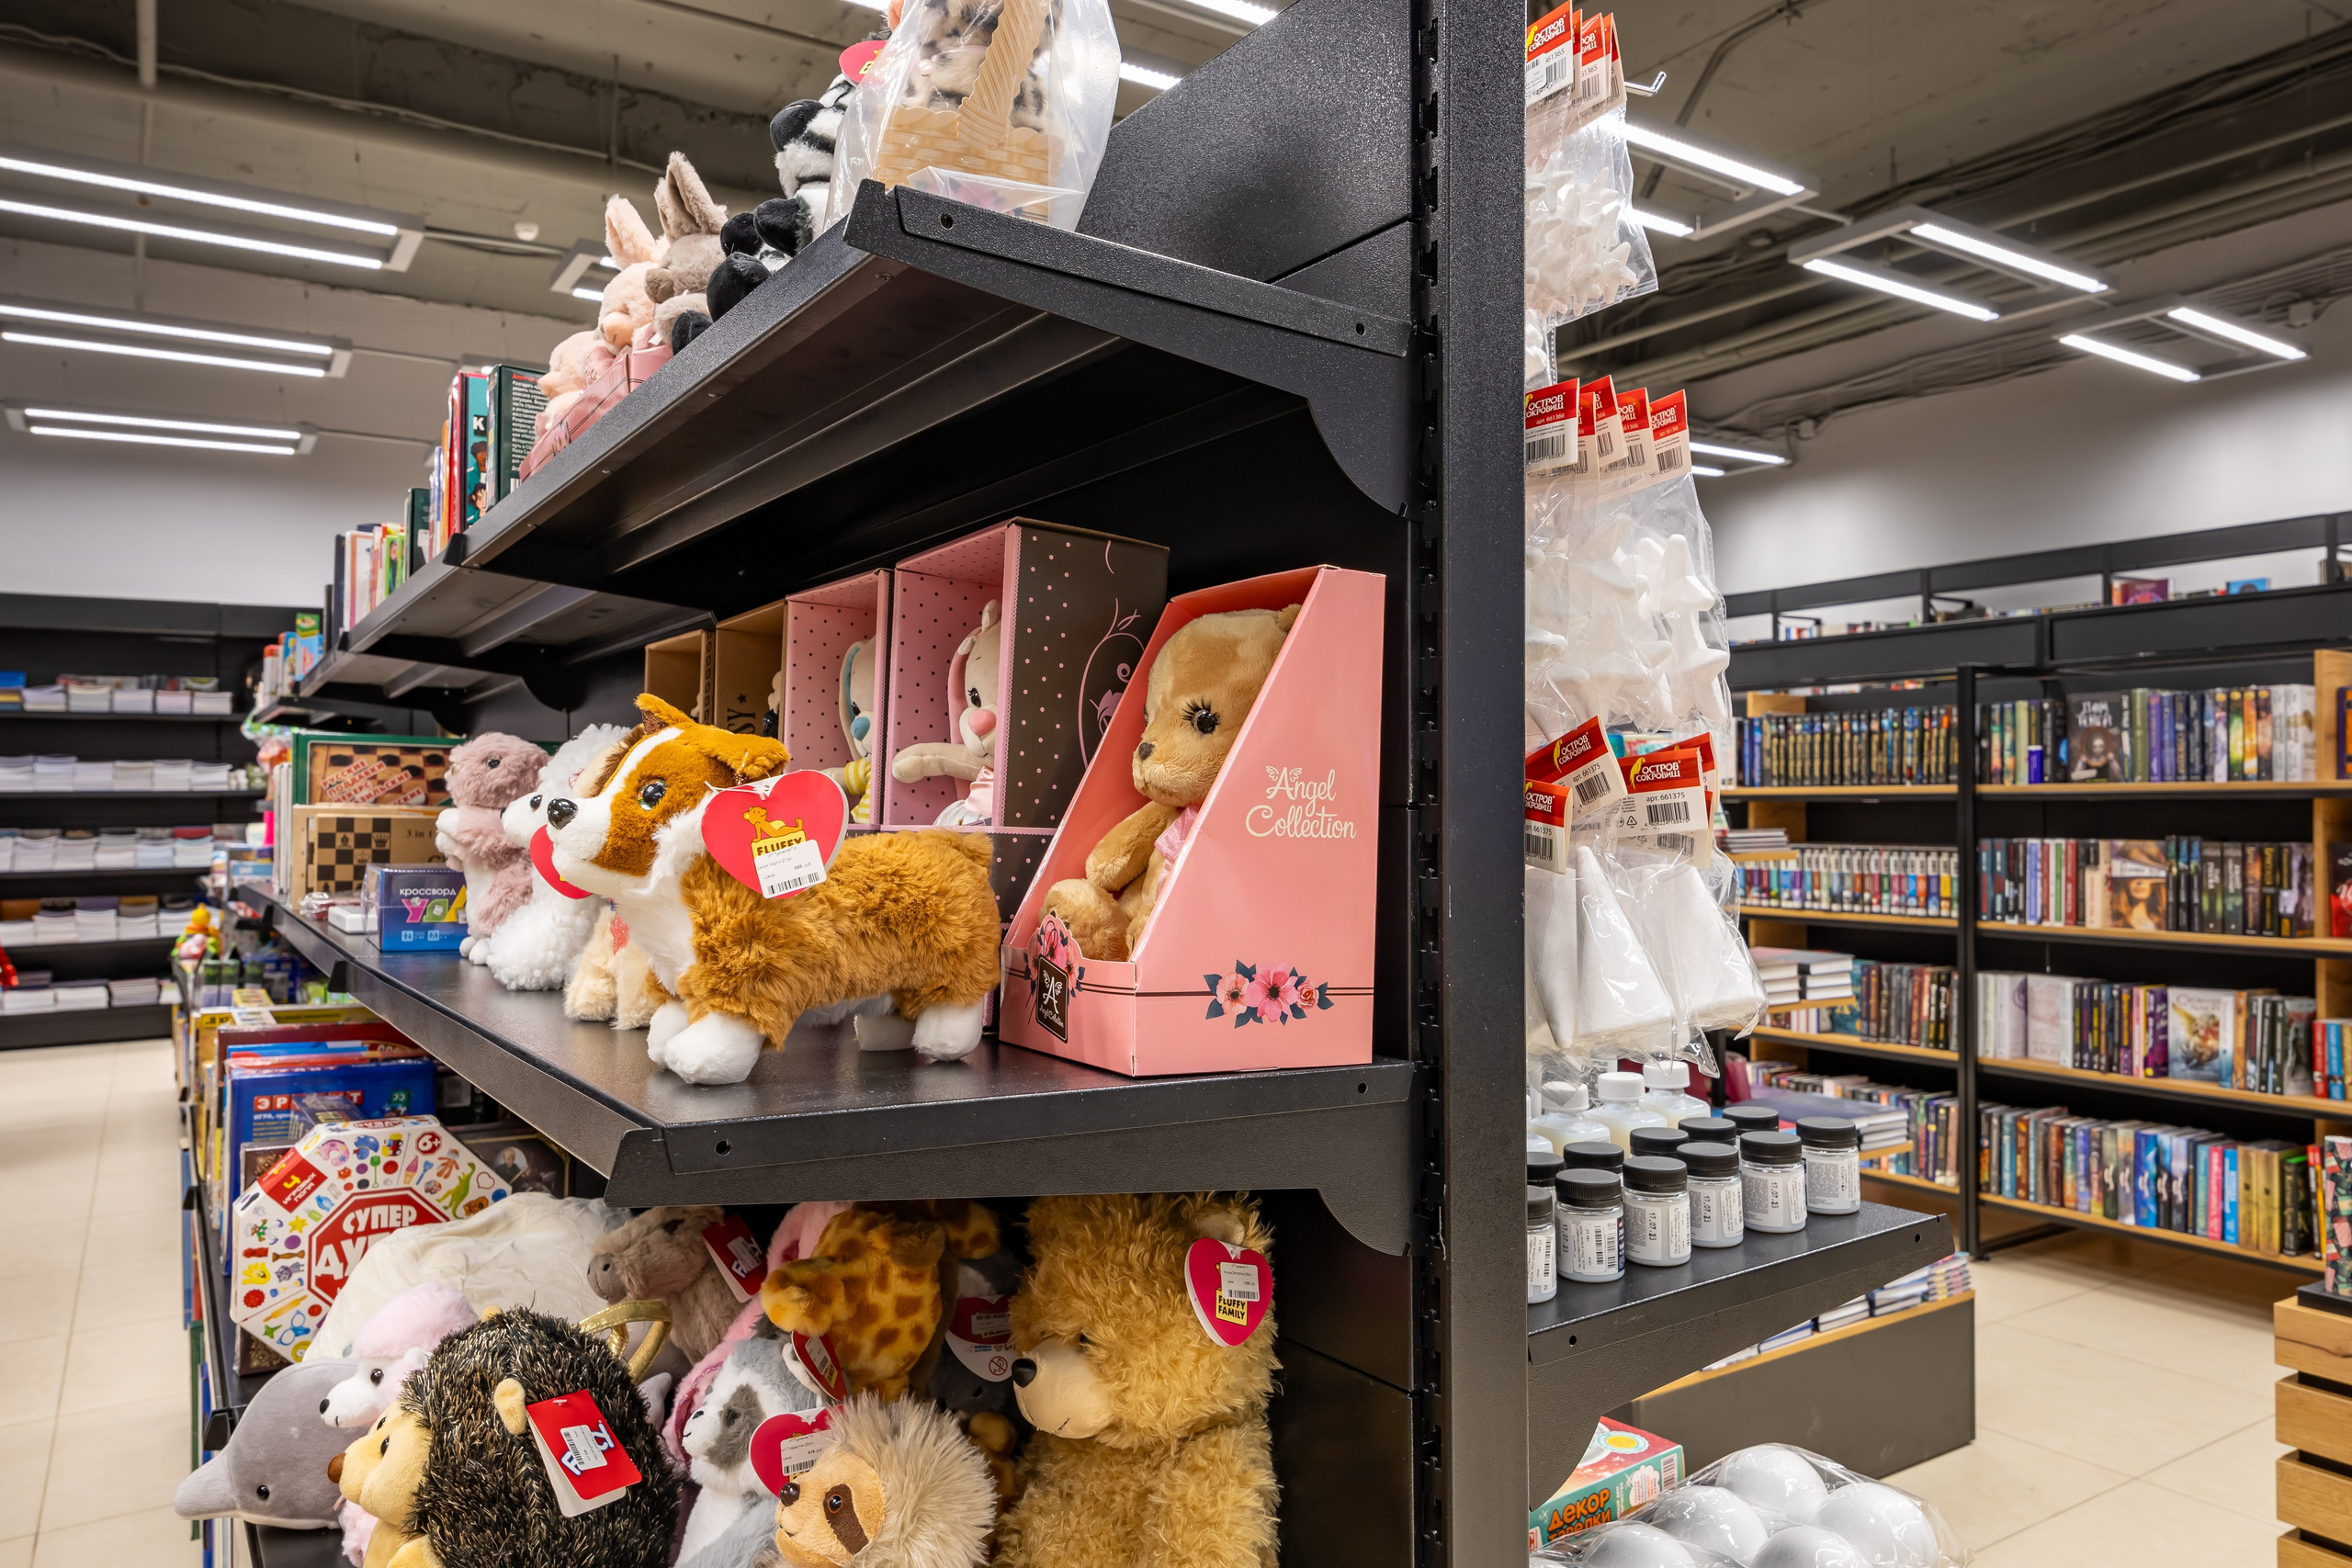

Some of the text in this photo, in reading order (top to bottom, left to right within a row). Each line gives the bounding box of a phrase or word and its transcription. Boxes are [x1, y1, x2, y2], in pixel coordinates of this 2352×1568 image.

[1529, 25, 1566, 52] СОКРОВИЩ
[1533, 17, 1565, 42] ОСТРОВ
[1528, 394, 1564, 411] ОСТРОВ
[1545, 413, 1566, 423] 661366
[1651, 407, 1676, 423] ОСТРОВ
[1558, 741, 1592, 765] СОКРОВИЩ
[1561, 734, 1589, 756] ОСТРОВ
[322, 760, 367, 788] РУССКИЕ
[1572, 762, 1601, 784] арт. 661375
[1635, 770, 1681, 782] СОКРОВИЩ
[1641, 761, 1679, 774] ОСТРОВ
[328, 761, 385, 796] ПОДДАВКИ
[1266, 766, 1337, 816] Angel
[1525, 792, 1553, 805] ОСТРОВ
[1659, 791, 1686, 801] 661375
[1246, 805, 1357, 840] Collection
[1532, 825, 1553, 836] 661375
[414, 829, 424, 838] in
[400, 887, 457, 897] кроссворд
[417, 1134, 441, 1152] 6+
[282, 1174, 301, 1190] 4
[282, 1171, 317, 1205] ИГРОВЫХ
[294, 1181, 315, 1202] ПОЛЯ
[1770, 1181, 1780, 1209] 17.07.23
[342, 1204, 417, 1235] СУПЕР
[1703, 1195, 1712, 1224] 17.07.23
[1648, 1212, 1657, 1242] 17.07.23
[1218, 1295, 1246, 1310] FLUFFY
[1218, 1304, 1246, 1320] FAMILY
